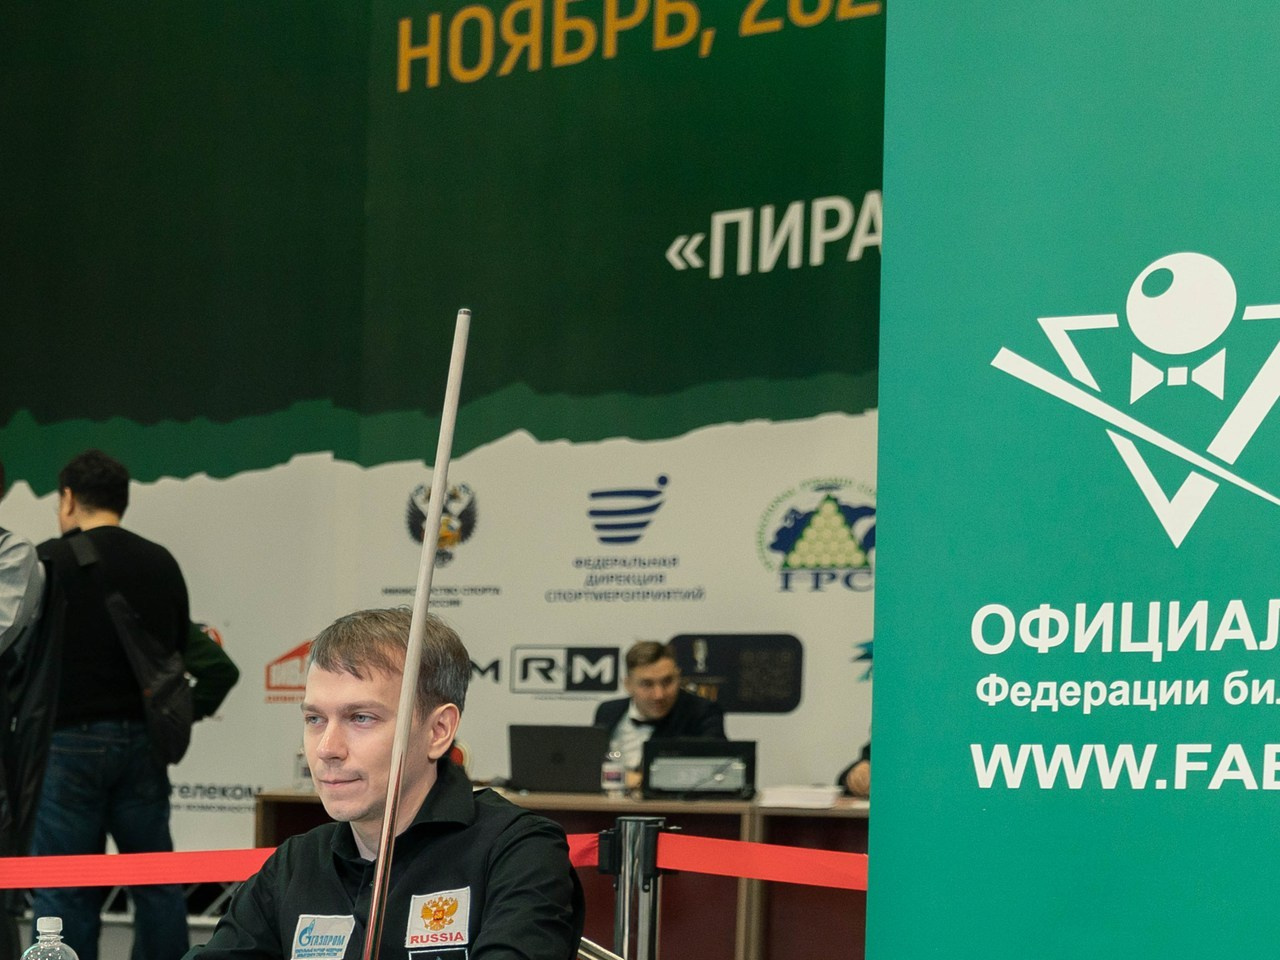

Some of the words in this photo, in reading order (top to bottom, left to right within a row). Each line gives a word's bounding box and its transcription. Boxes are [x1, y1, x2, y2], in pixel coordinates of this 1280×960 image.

[395, 0, 717, 93] НОЯБРЬ,
[975, 673, 1210, 715] Федерации
[1223, 670, 1280, 706] би
[410, 931, 464, 945] RUSSIA
